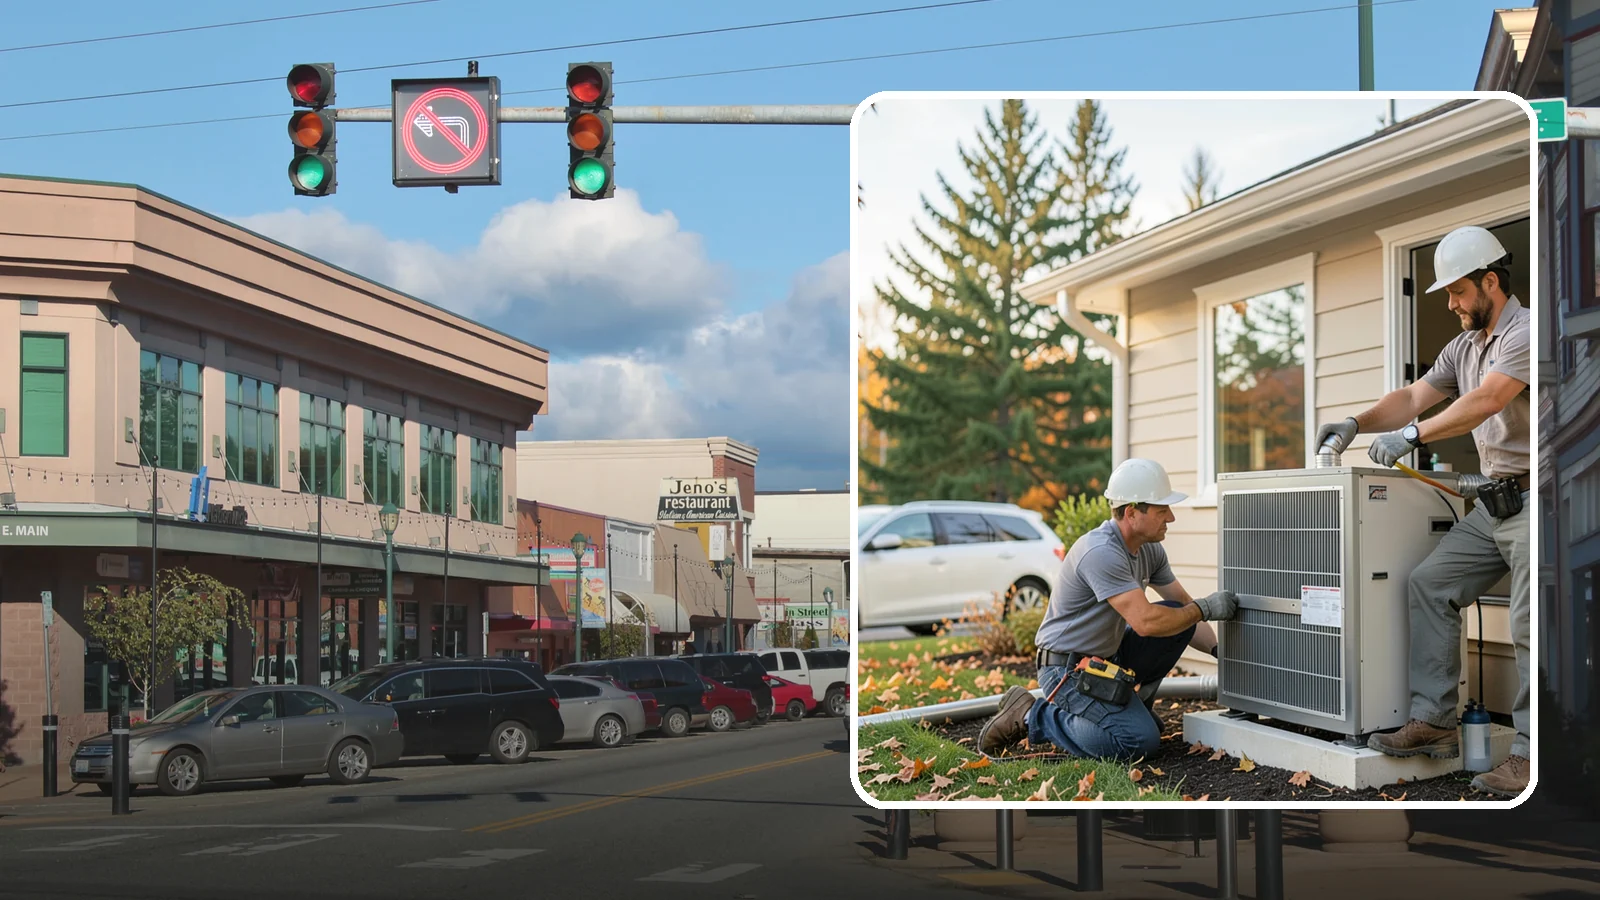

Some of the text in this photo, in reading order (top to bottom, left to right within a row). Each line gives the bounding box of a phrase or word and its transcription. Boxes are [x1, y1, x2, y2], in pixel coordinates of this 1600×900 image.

[669, 480, 728, 495] Jeno's
[665, 496, 731, 509] restaurant
[658, 510, 682, 520] Italian
[686, 509, 714, 520] American
[715, 509, 738, 519] Cuisine
[2, 525, 49, 536] E. MAIN
[797, 607, 829, 617] Street
